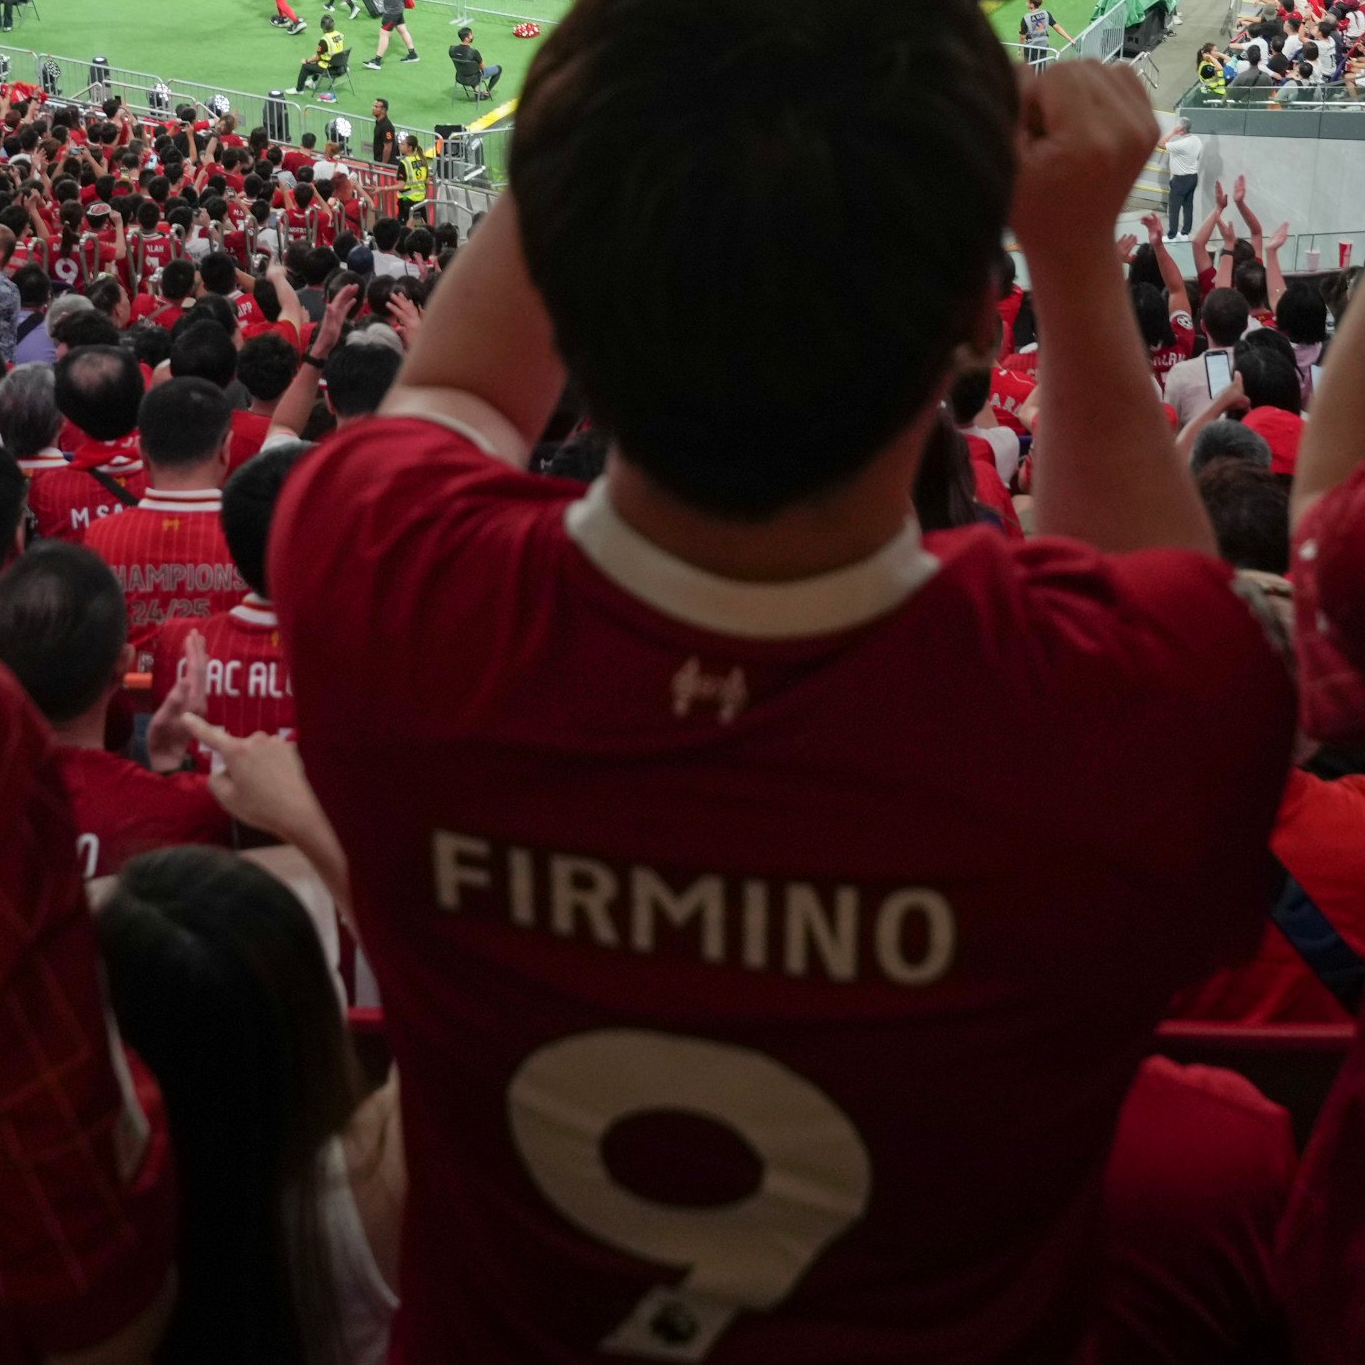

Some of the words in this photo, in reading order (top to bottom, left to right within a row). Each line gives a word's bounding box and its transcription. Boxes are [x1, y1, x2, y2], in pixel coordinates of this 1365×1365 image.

[54, 257, 79, 285] 9
[115, 563, 248, 592] HAMPIONS
[436, 829, 959, 989] FIRMINO
[504, 1027, 875, 1363] 9
